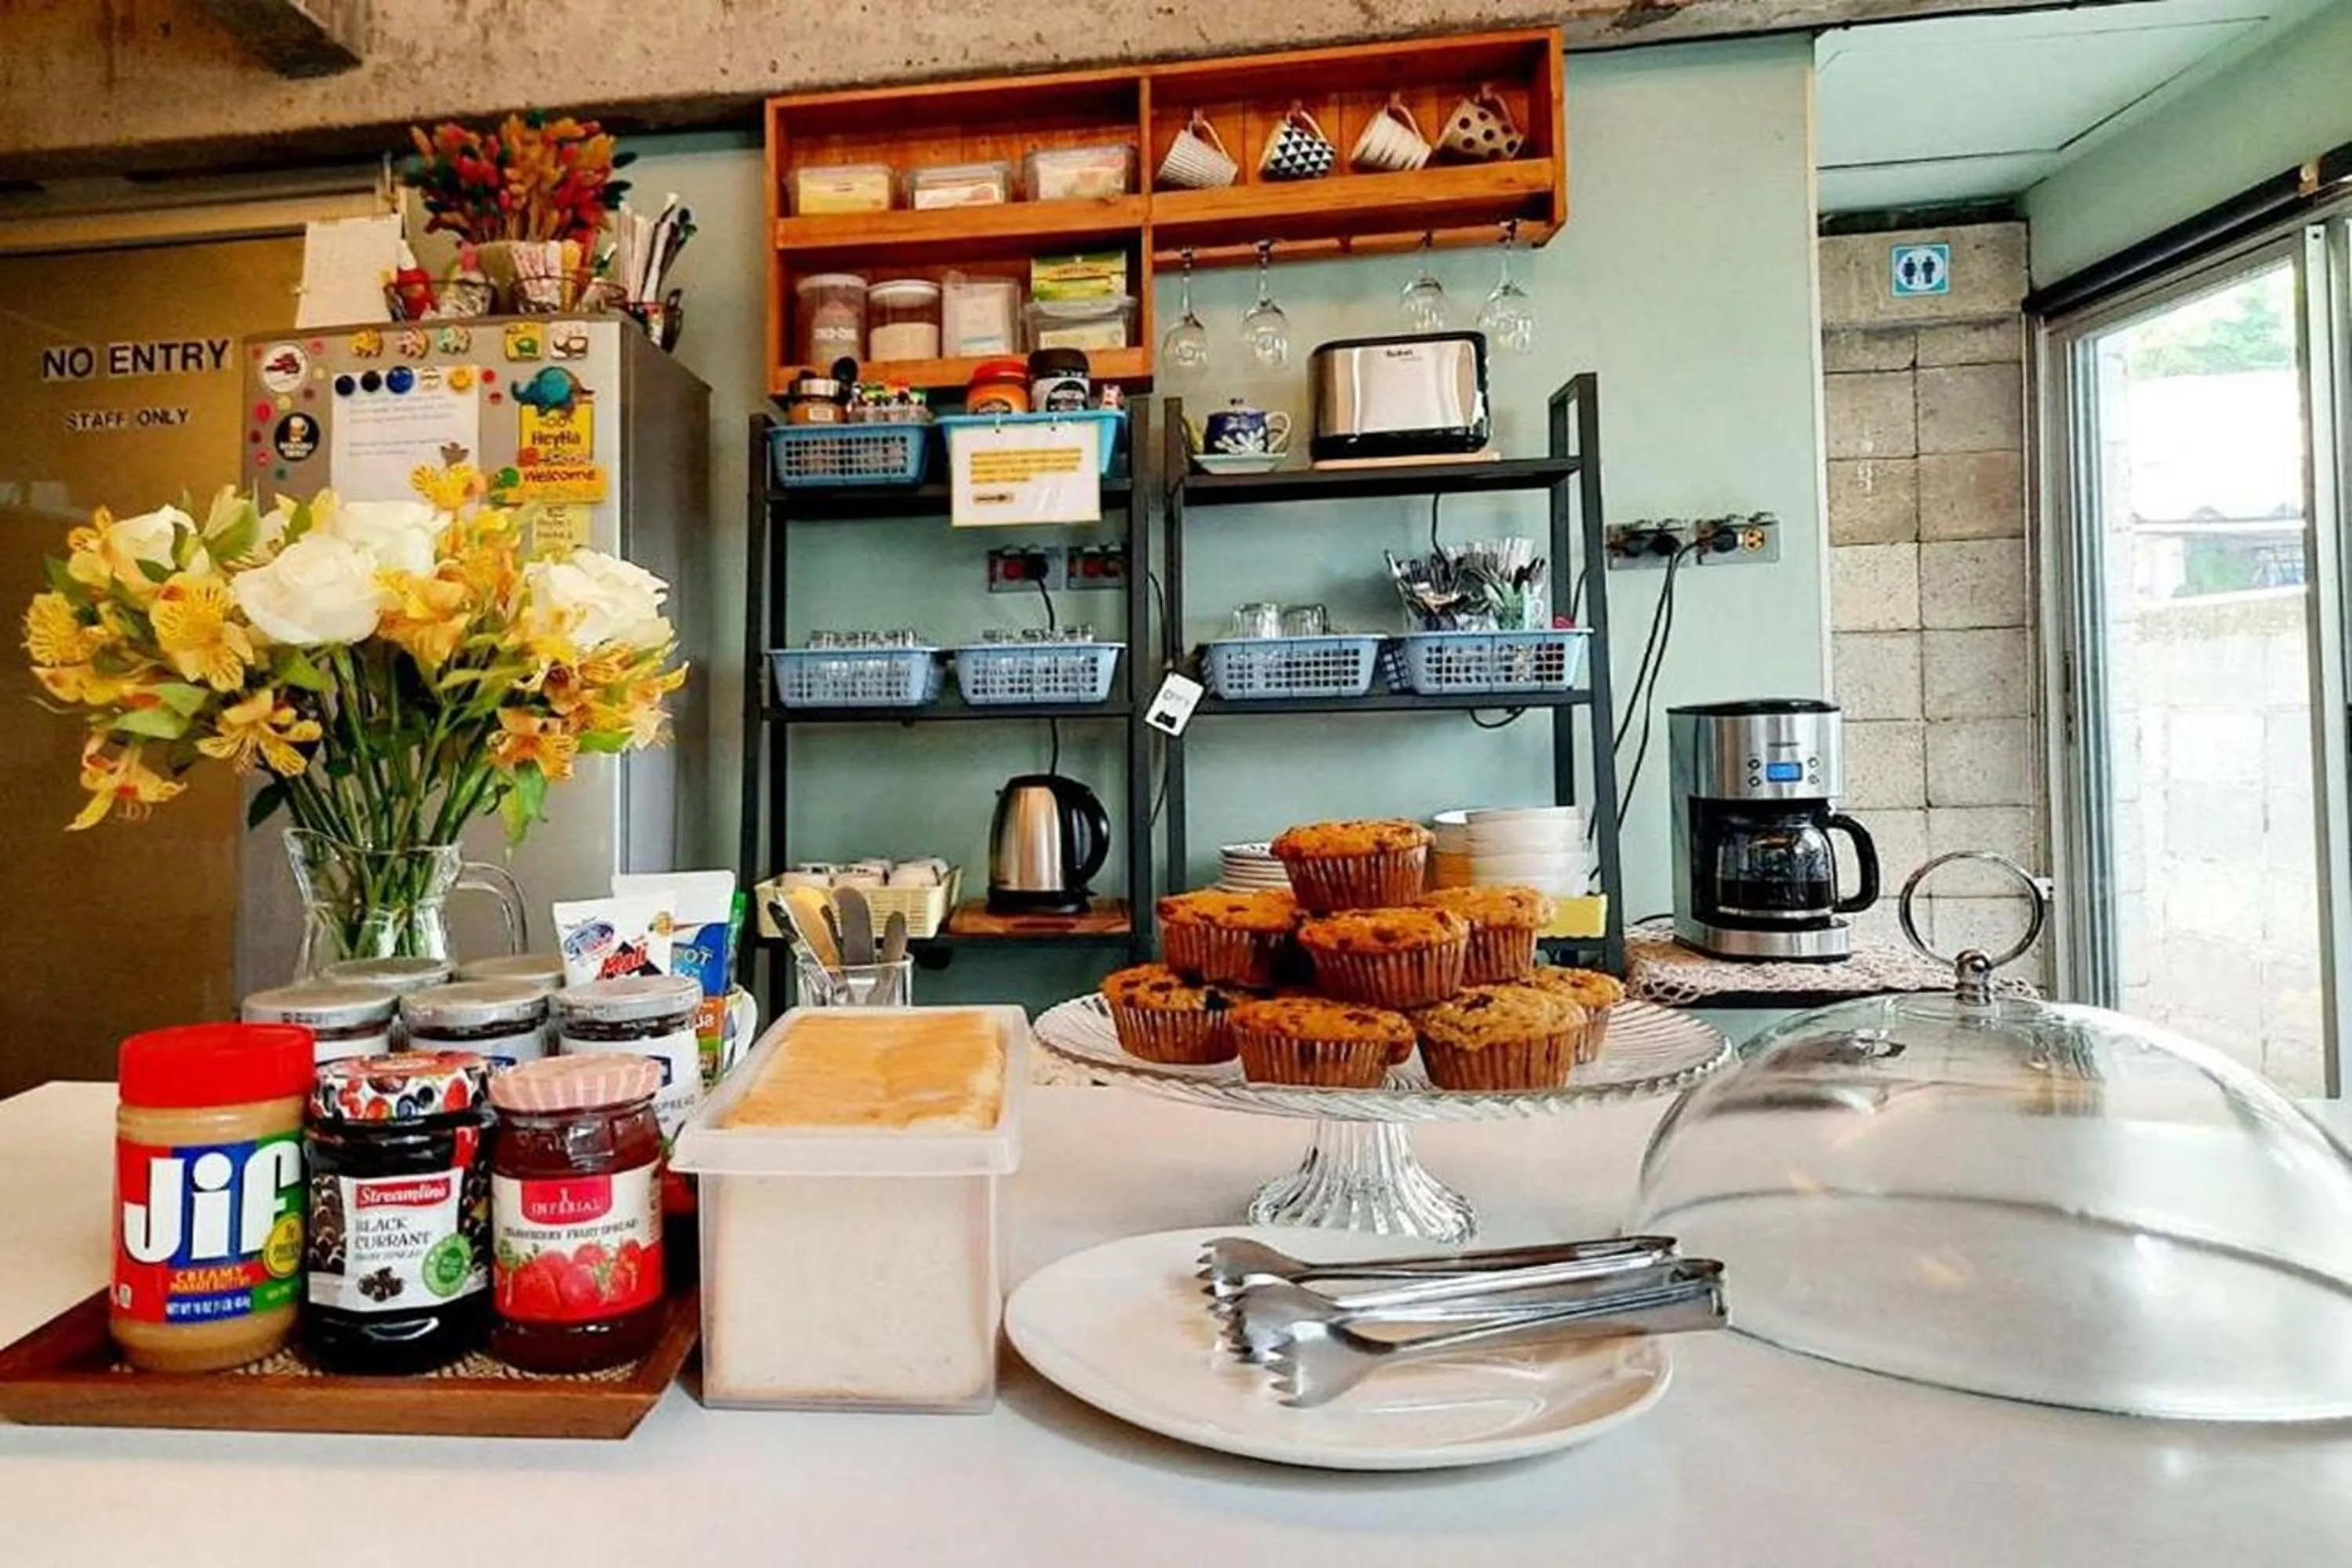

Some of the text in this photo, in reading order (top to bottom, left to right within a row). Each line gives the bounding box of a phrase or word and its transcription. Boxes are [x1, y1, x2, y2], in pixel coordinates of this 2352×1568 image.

[42, 339, 230, 378] NO ENTRY
[66, 408, 189, 431] STAFF ONLY
[123, 1140, 301, 1263] Jif
[355, 1216, 406, 1232] BLACK
[355, 1231, 430, 1248] CURRANT
